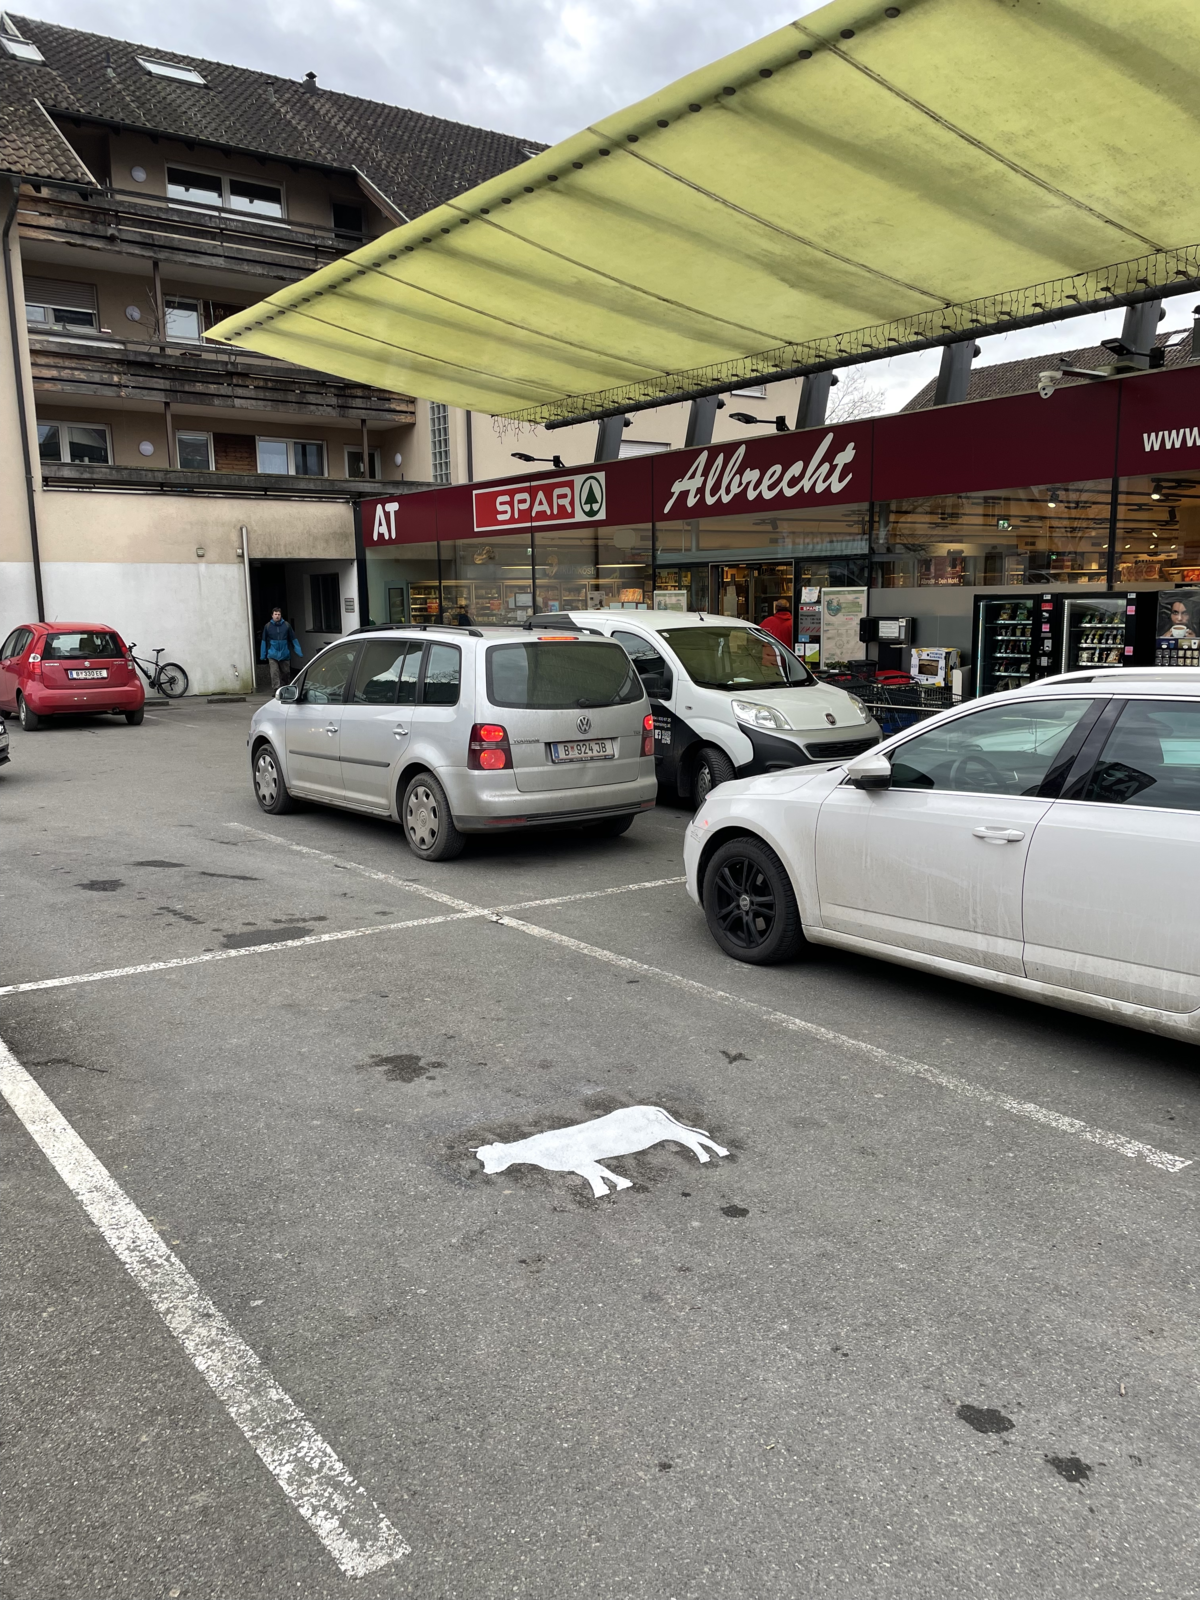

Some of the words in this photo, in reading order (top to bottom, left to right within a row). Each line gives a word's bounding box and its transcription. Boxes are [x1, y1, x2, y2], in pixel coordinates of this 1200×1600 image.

[664, 432, 856, 513] Albrecht
[372, 502, 399, 541] AT
[496, 487, 572, 520] SPAR
[563, 745, 570, 756] B
[576, 743, 594, 755] 924
[595, 742, 607, 753] JB
